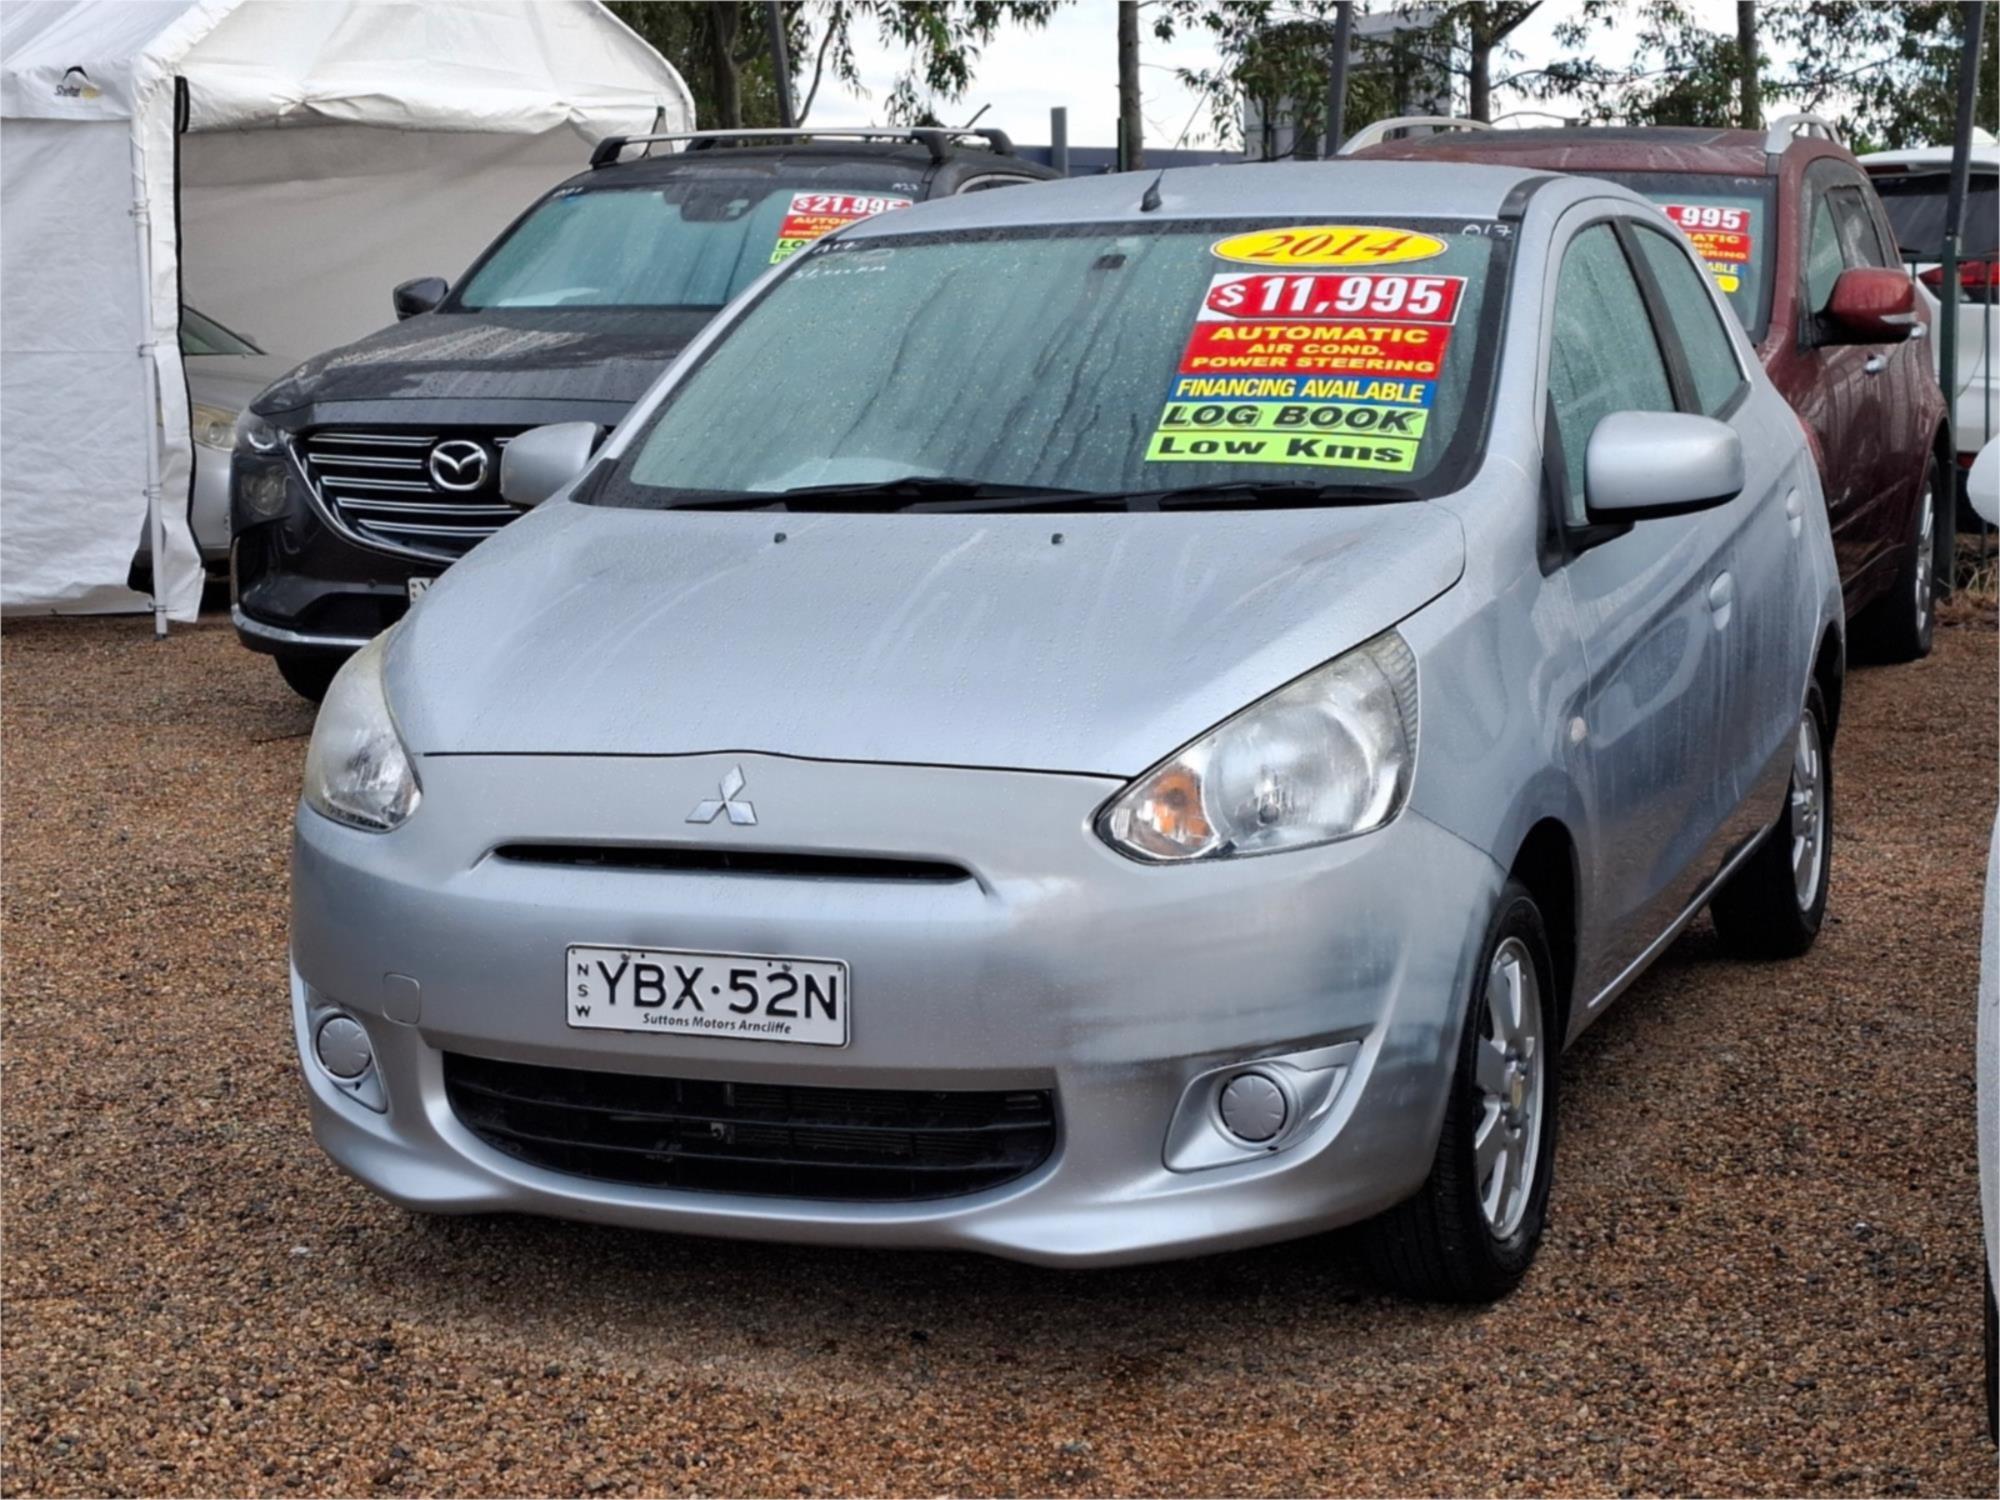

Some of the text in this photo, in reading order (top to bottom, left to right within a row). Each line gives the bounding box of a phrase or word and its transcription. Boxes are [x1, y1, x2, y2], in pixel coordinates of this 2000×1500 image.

[778, 239, 805, 250] LO
[1250, 233, 1411, 258] 2014
[1699, 250, 1747, 260] ERING
[1211, 325, 1429, 343] AUTOMATIC
[1247, 342, 1386, 356] AIR COND.
[1191, 356, 1436, 373] POWER STEERING
[1176, 378, 1425, 403] FINANCING AVAILABLE
[1162, 404, 1423, 434] LOG BOOK
[1158, 436, 1405, 463] Low Kms
[643, 1013, 792, 1035] Suttons Motors Arncliffe
